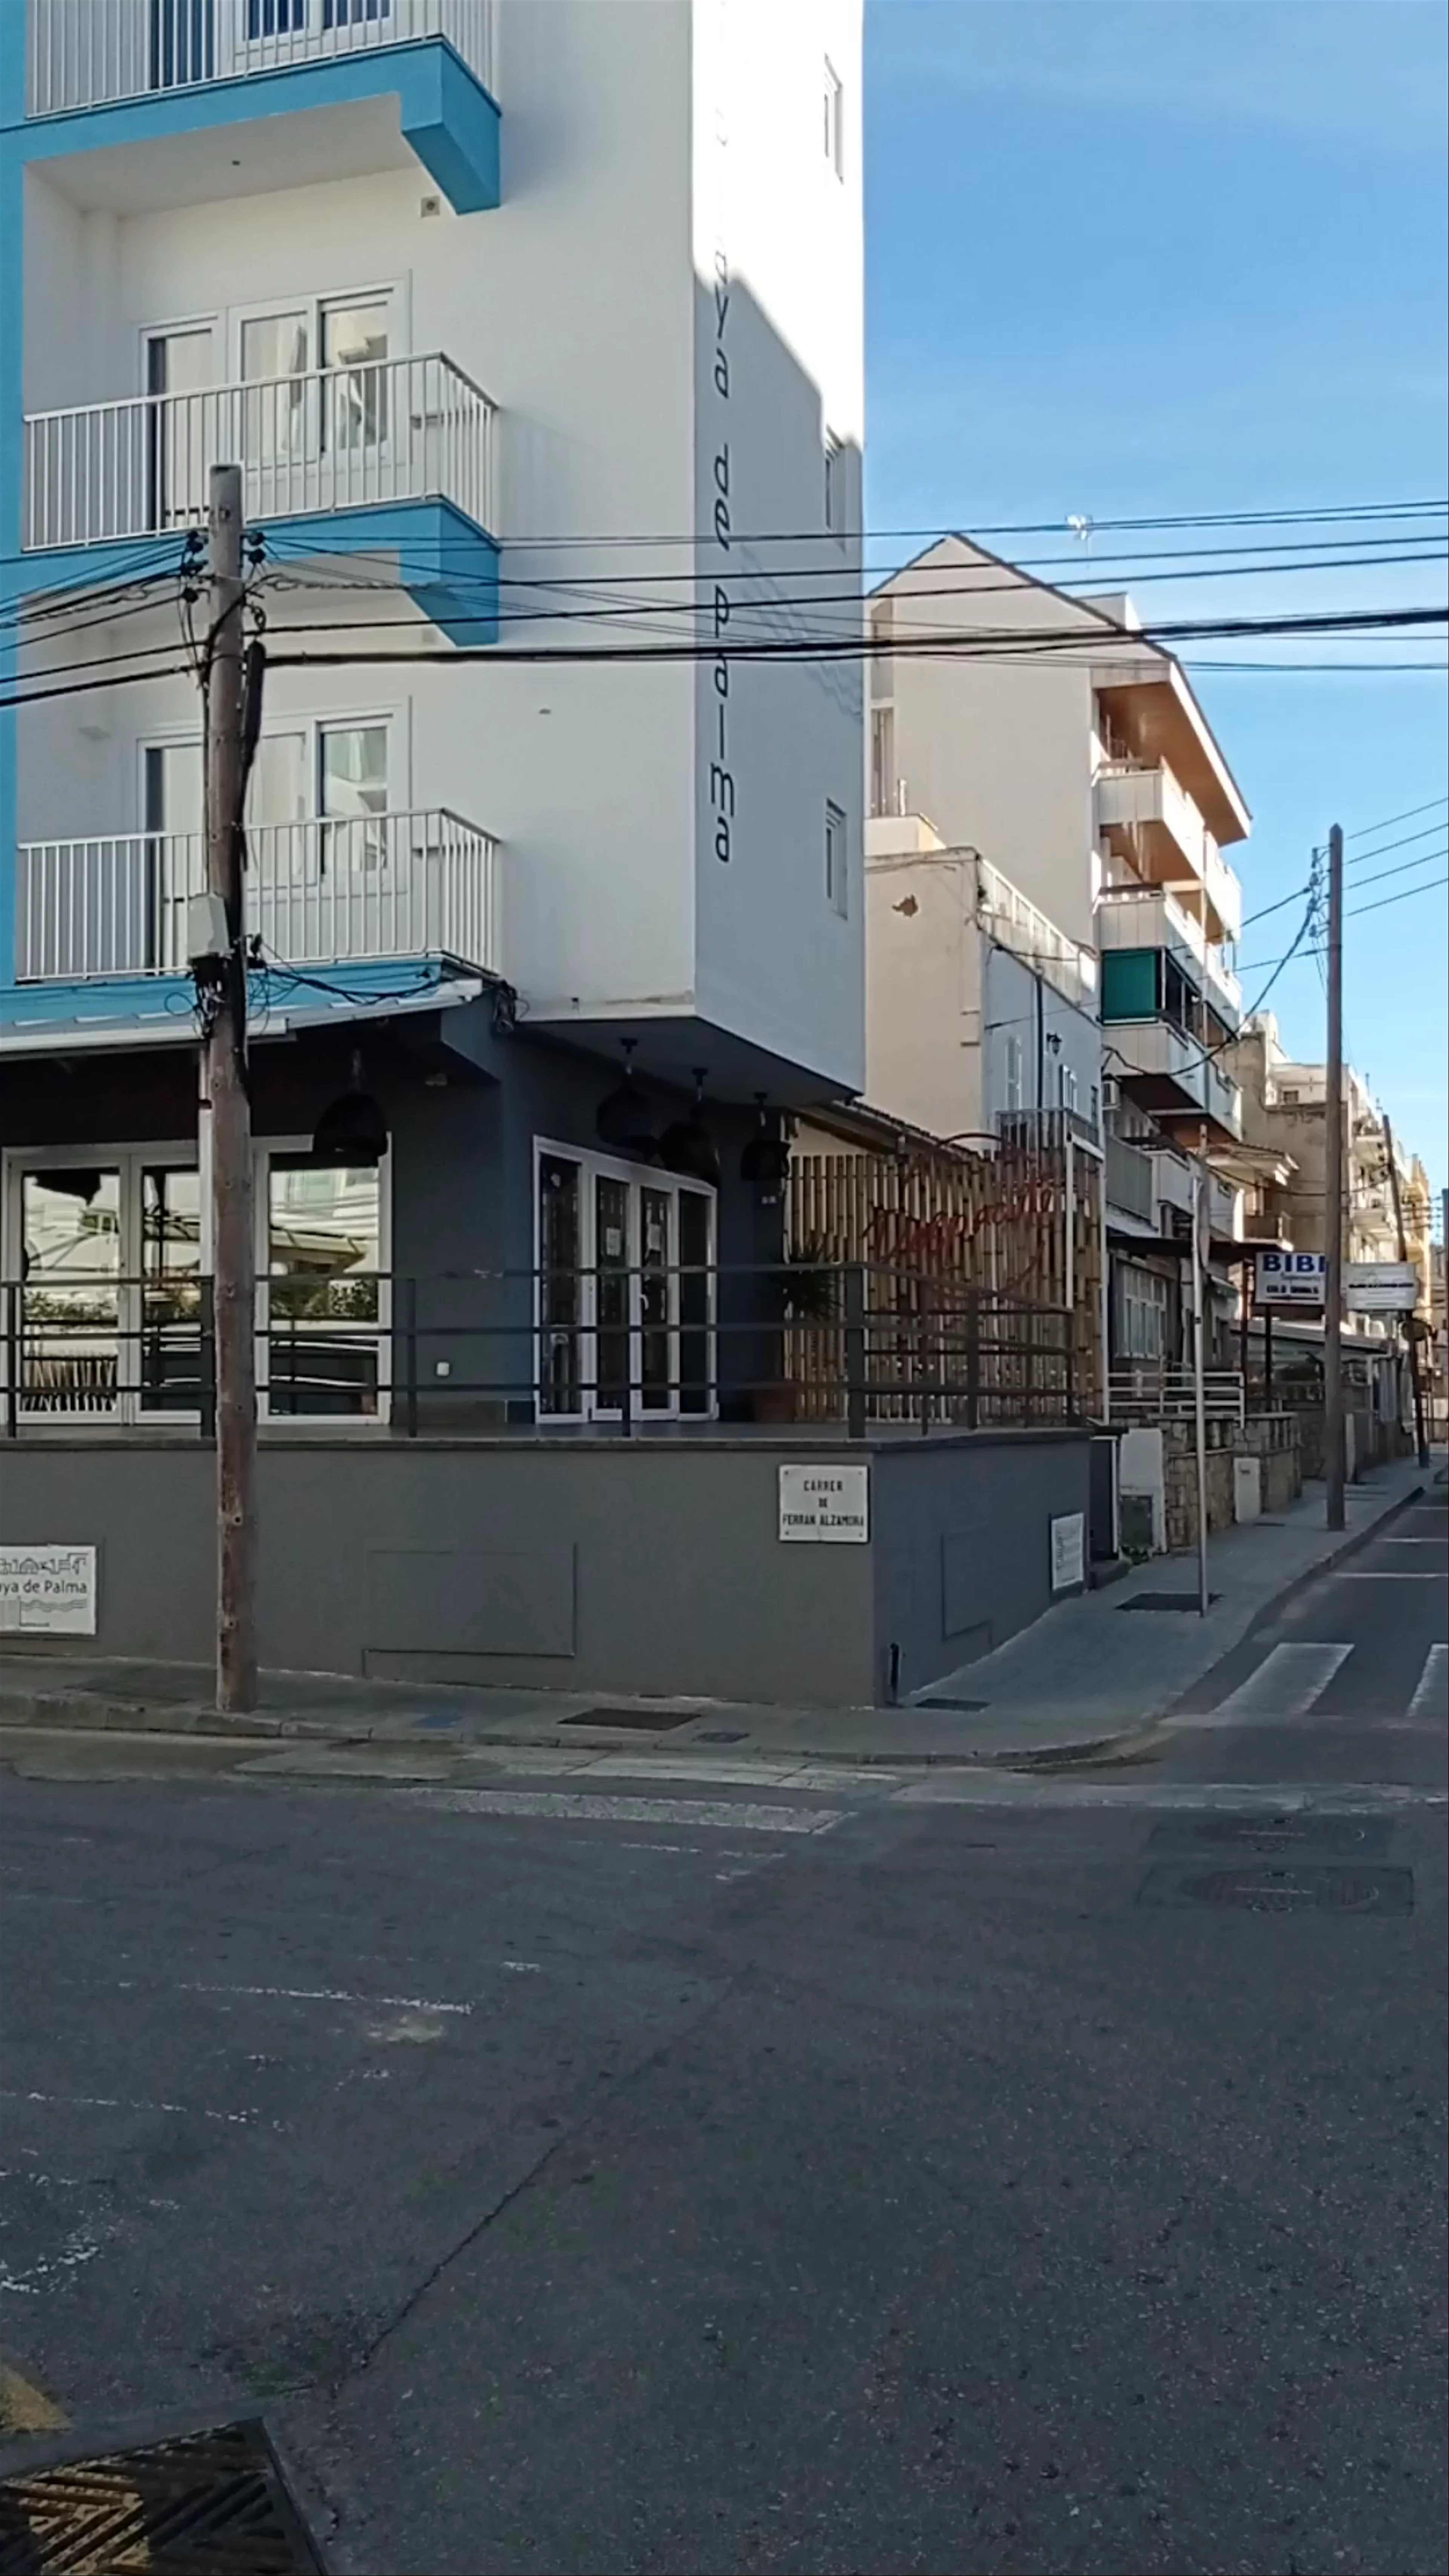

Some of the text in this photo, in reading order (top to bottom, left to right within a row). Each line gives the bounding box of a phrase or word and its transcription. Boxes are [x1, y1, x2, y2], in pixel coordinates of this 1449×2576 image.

[714, 442, 730, 552] de
[711, 584, 734, 863] palma
[804, 1479, 843, 1492] CARRER
[783, 1513, 864, 1527] FERRAN ALZAMORA
[0, 1578, 87, 1596] ya de Palma
